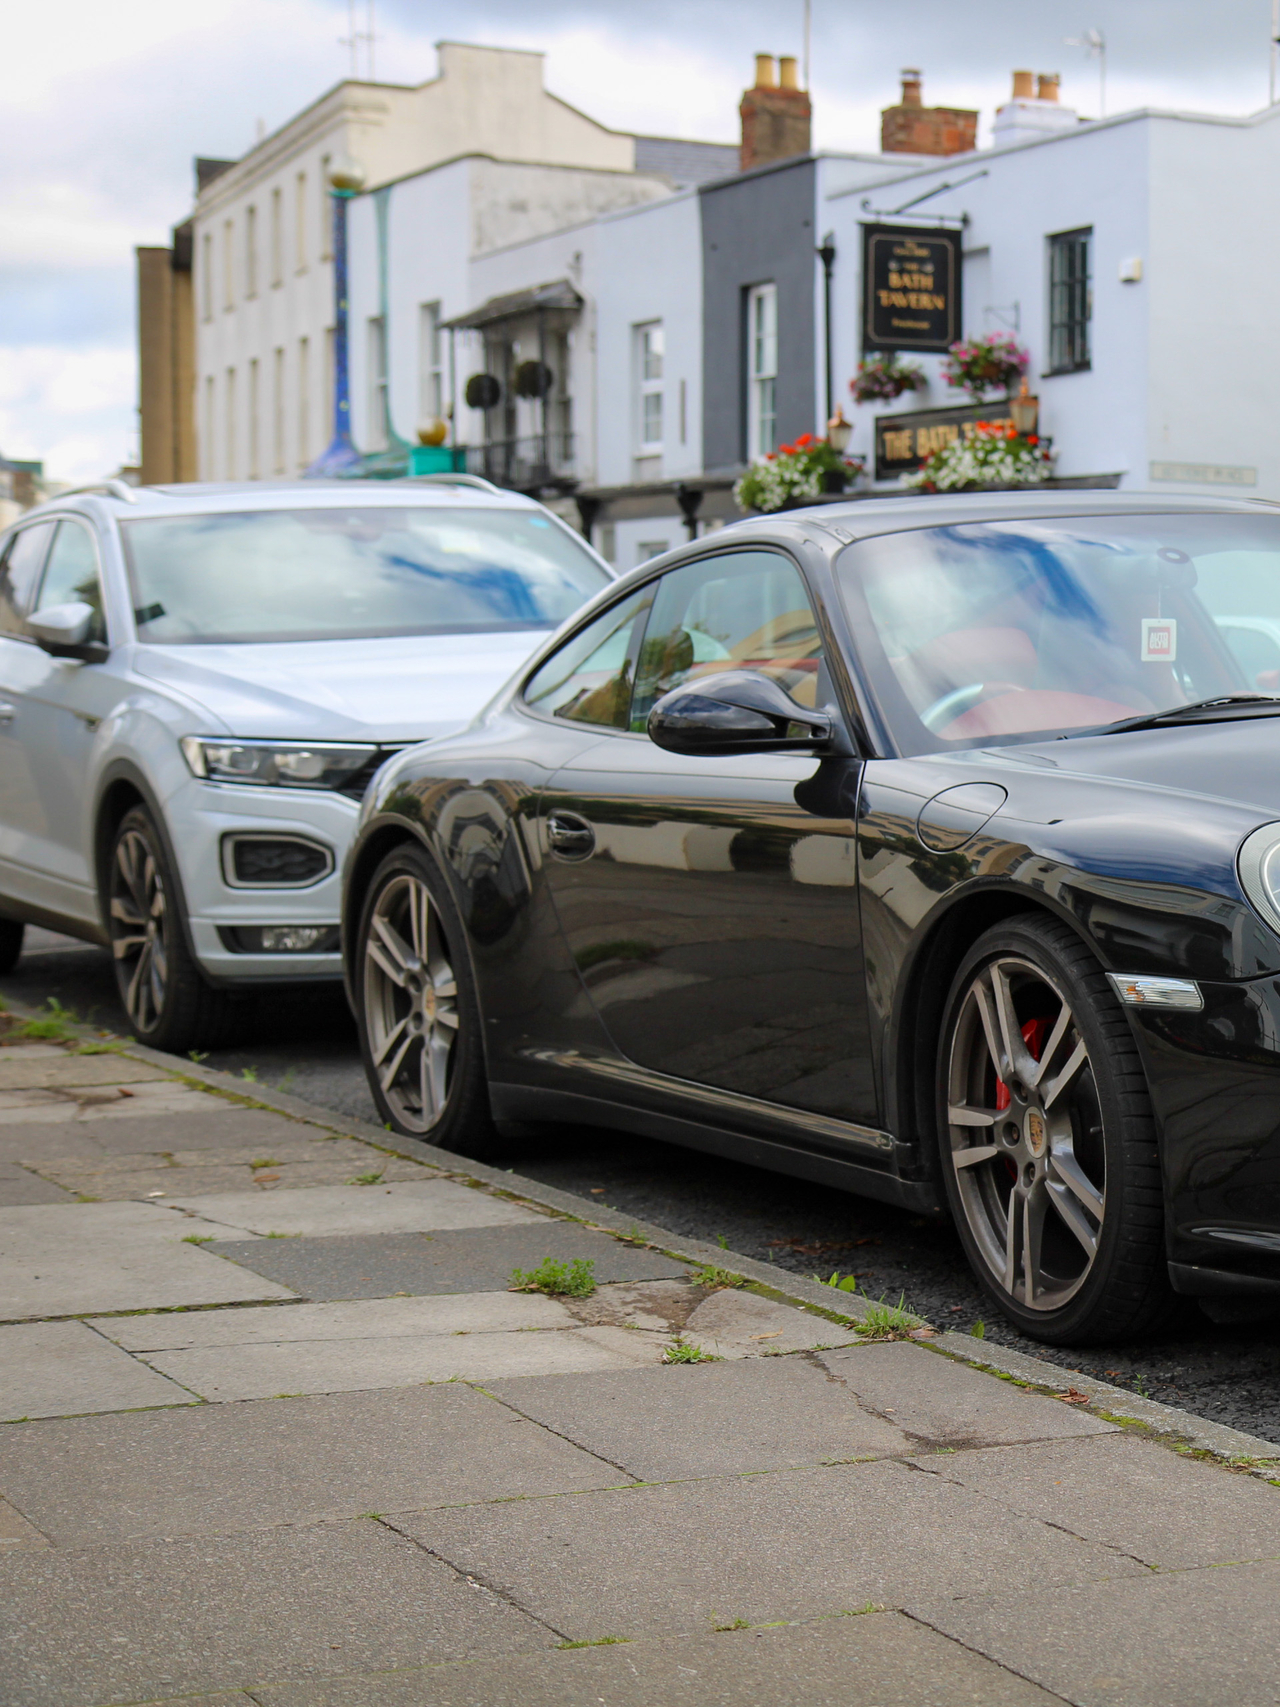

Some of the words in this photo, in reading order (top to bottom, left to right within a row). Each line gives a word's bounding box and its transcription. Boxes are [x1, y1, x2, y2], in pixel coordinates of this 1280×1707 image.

[889, 272, 933, 290] BATH
[878, 290, 945, 310] TAVERN
[884, 431, 913, 460] THE
[1151, 632, 1168, 641] AUTO
